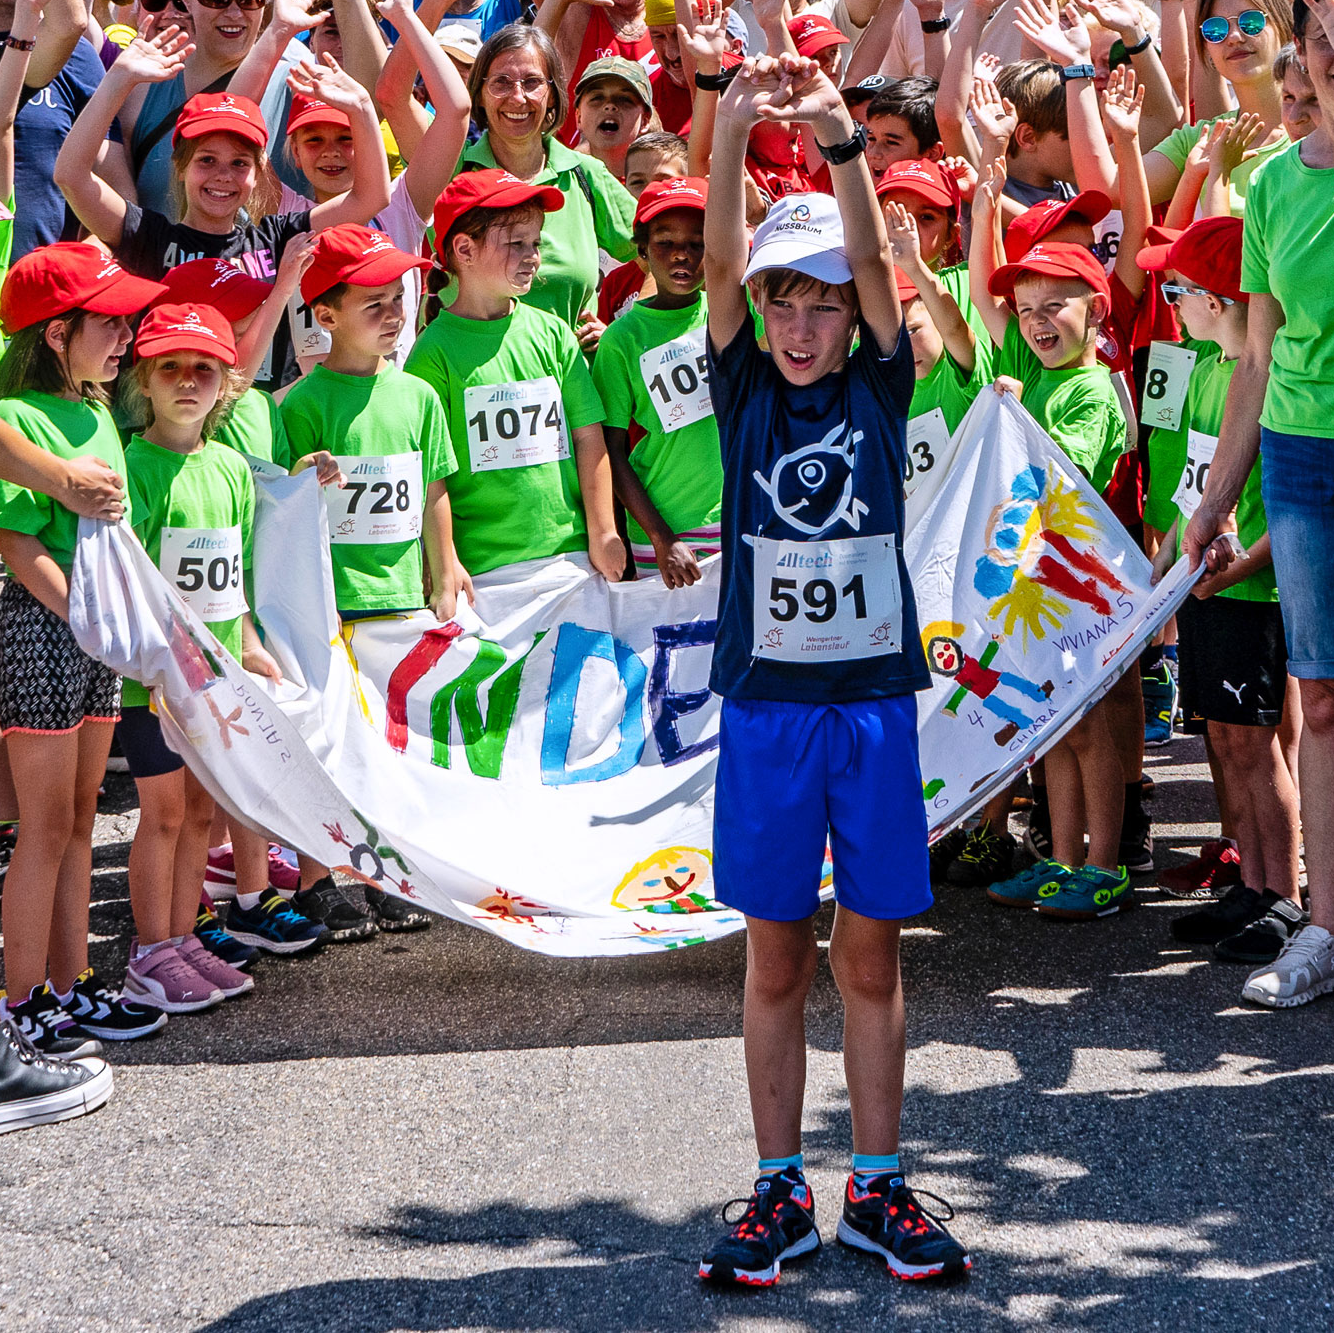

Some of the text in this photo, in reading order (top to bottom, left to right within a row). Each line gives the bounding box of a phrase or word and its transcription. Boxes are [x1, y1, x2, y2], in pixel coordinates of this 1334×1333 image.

[774, 222, 822, 235] NUSSBAUM
[659, 342, 696, 365] Alltech
[487, 387, 527, 403] Alltech
[1146, 368, 1169, 400] 8
[468, 400, 562, 443] 1074
[350, 462, 392, 475] Alltech
[342, 479, 411, 515] 728
[186, 537, 230, 550] Alltech
[175, 553, 240, 592] 505
[776, 552, 833, 569] Alltech
[768, 573, 868, 624] 591
[1052, 616, 1119, 653] VIVIANA
[1116, 591, 1135, 620] 5
[800, 640, 851, 651] Lebenslauf
[967, 707, 1060, 753] 4 CHIARA
